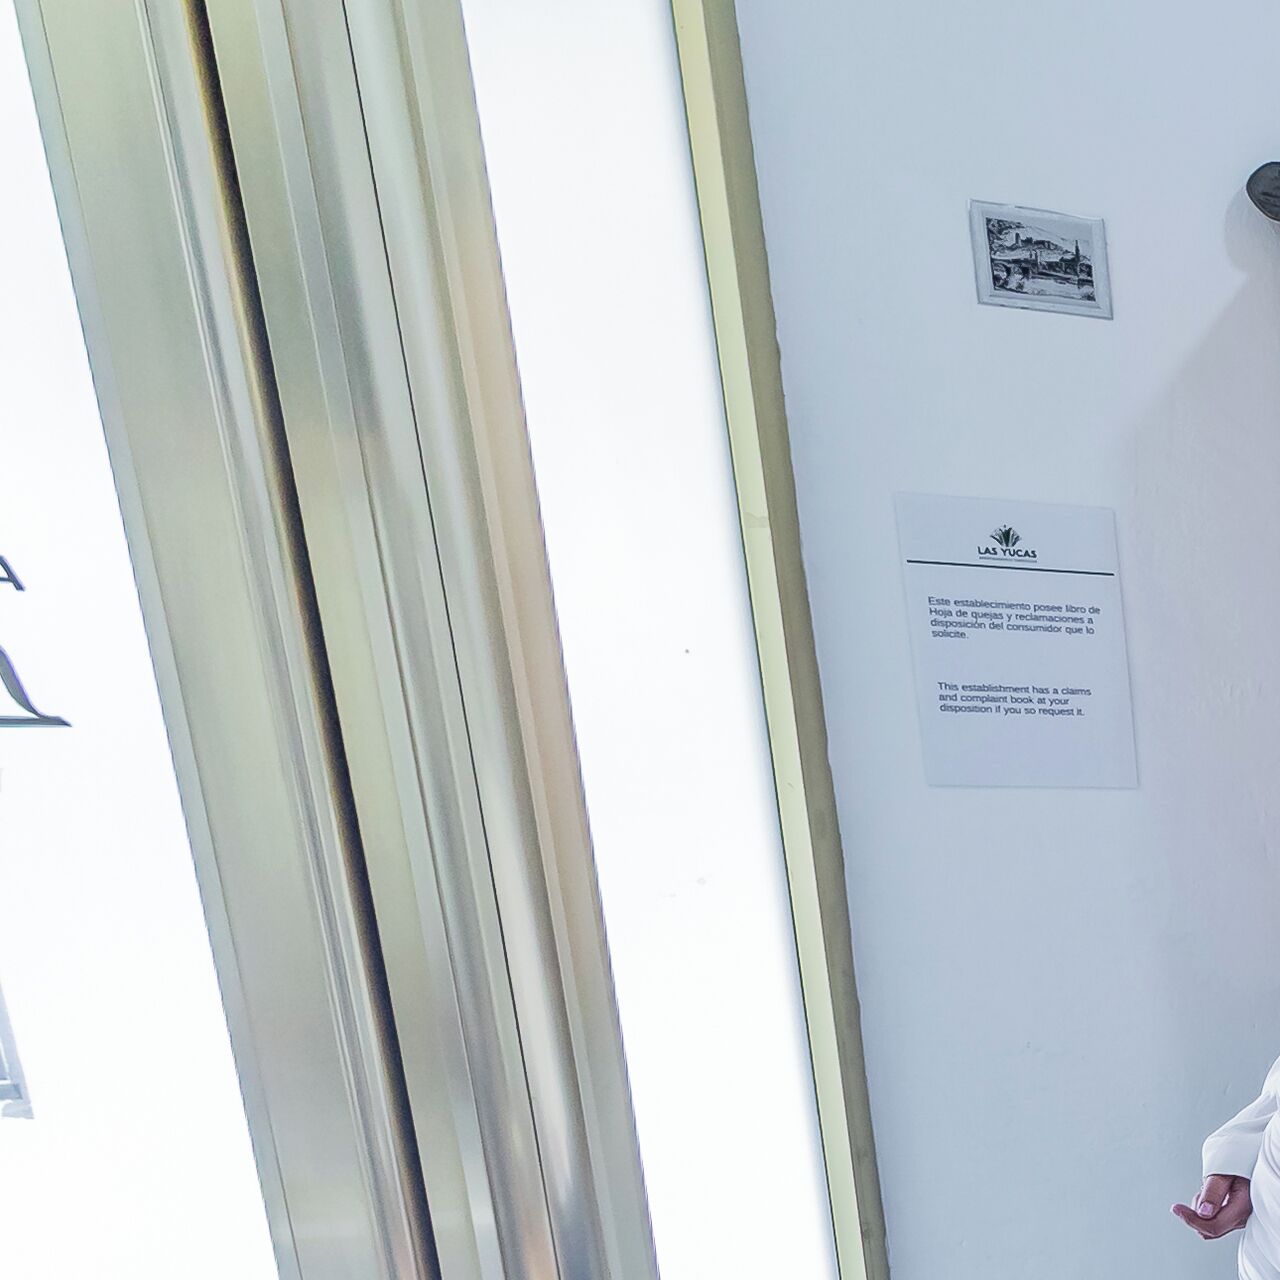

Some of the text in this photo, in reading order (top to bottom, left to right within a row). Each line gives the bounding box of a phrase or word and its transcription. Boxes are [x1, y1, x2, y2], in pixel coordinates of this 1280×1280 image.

[977, 546, 1037, 558] LAS YUCAS
[928, 596, 1101, 615] Este establecimiento posee libro de
[929, 607, 953, 619] Hoja
[955, 609, 968, 618] de
[971, 611, 1004, 621] quejas
[1006, 613, 1012, 622] y
[1015, 613, 1085, 624] reclamaciones
[930, 618, 1095, 635] disposición del consumidor que lo
[931, 629, 969, 639] solicite.
[937, 682, 1092, 696] This establishment has a claims
[938, 693, 1069, 707] and complaint book at your
[939, 703, 992, 713] disposition
[1003, 707, 1022, 716] you
[1038, 708, 1075, 717] request
[1076, 708, 1085, 716] it.
